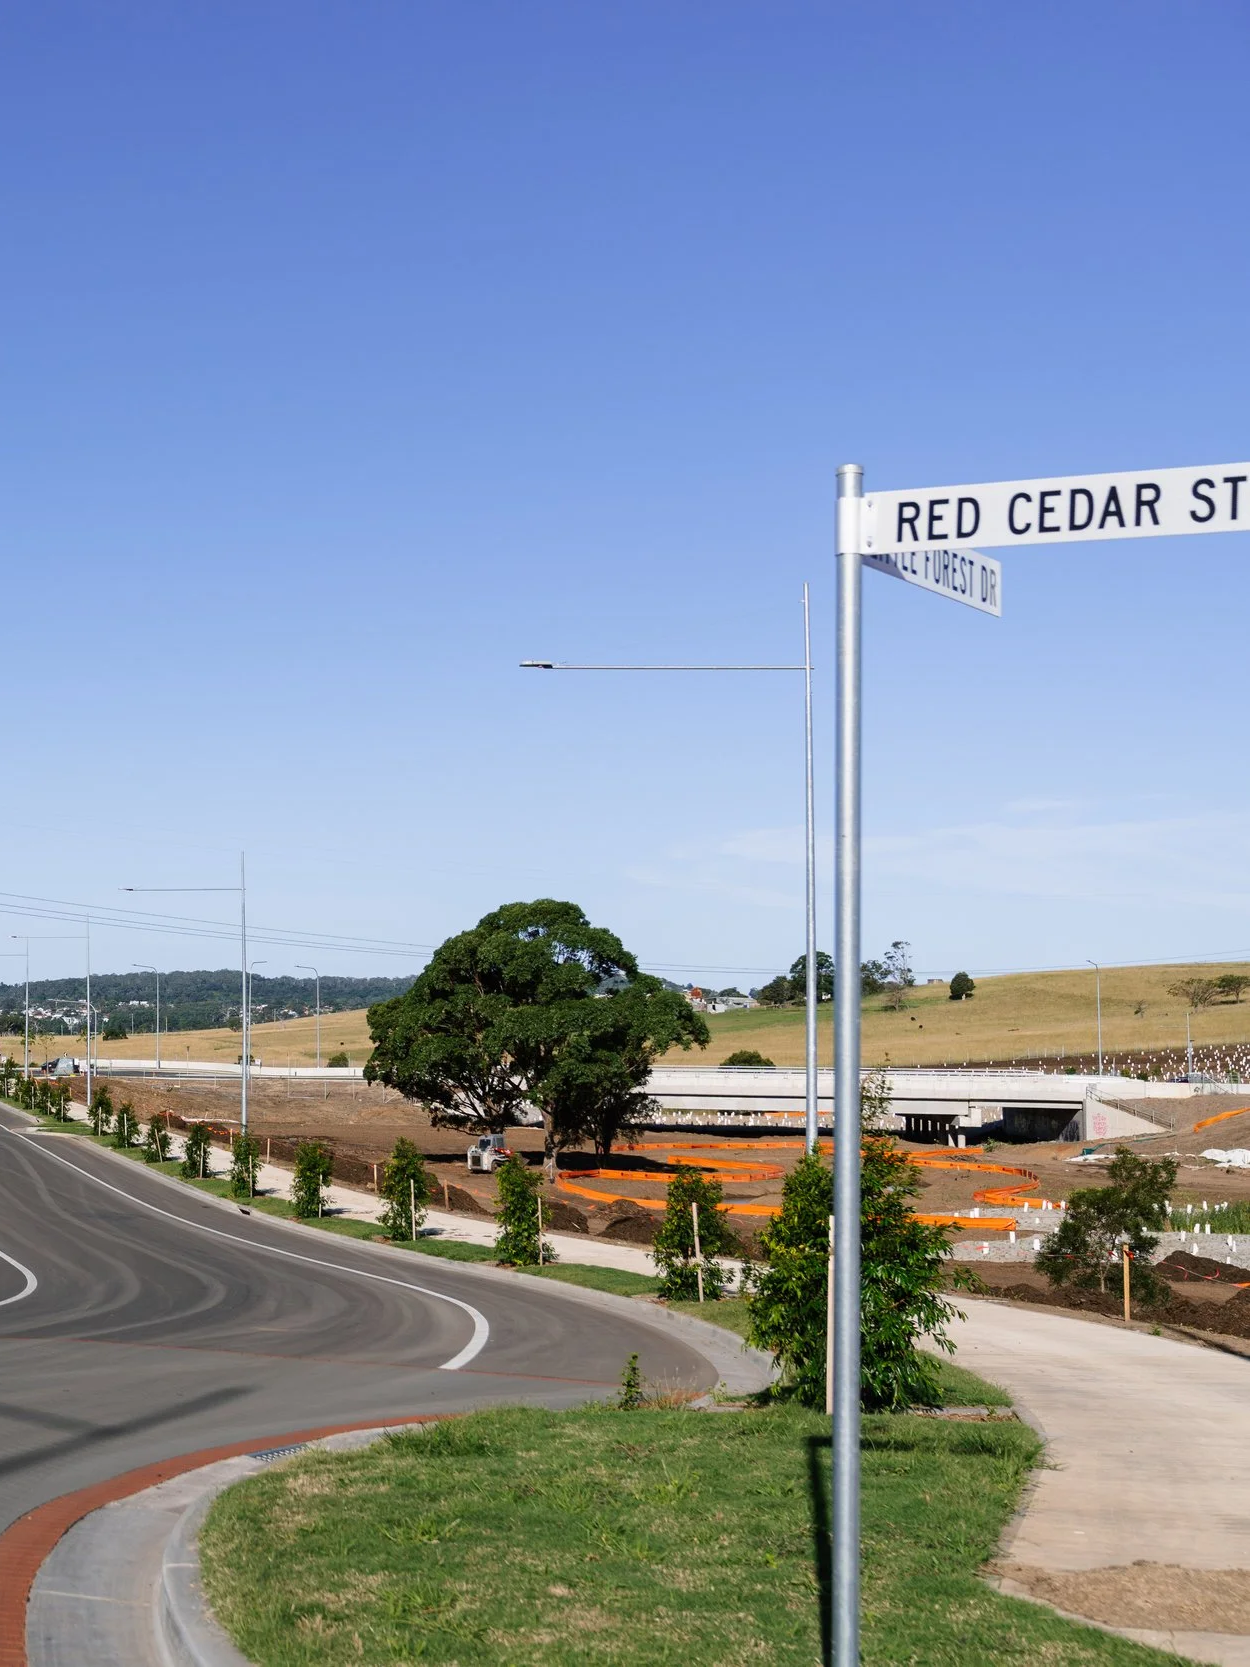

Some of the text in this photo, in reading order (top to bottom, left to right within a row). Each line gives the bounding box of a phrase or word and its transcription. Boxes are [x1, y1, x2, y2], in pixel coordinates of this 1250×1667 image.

[897, 476, 1247, 542] RED CEDAR ST
[925, 550, 974, 598] FOREST
[981, 565, 997, 607] DR
